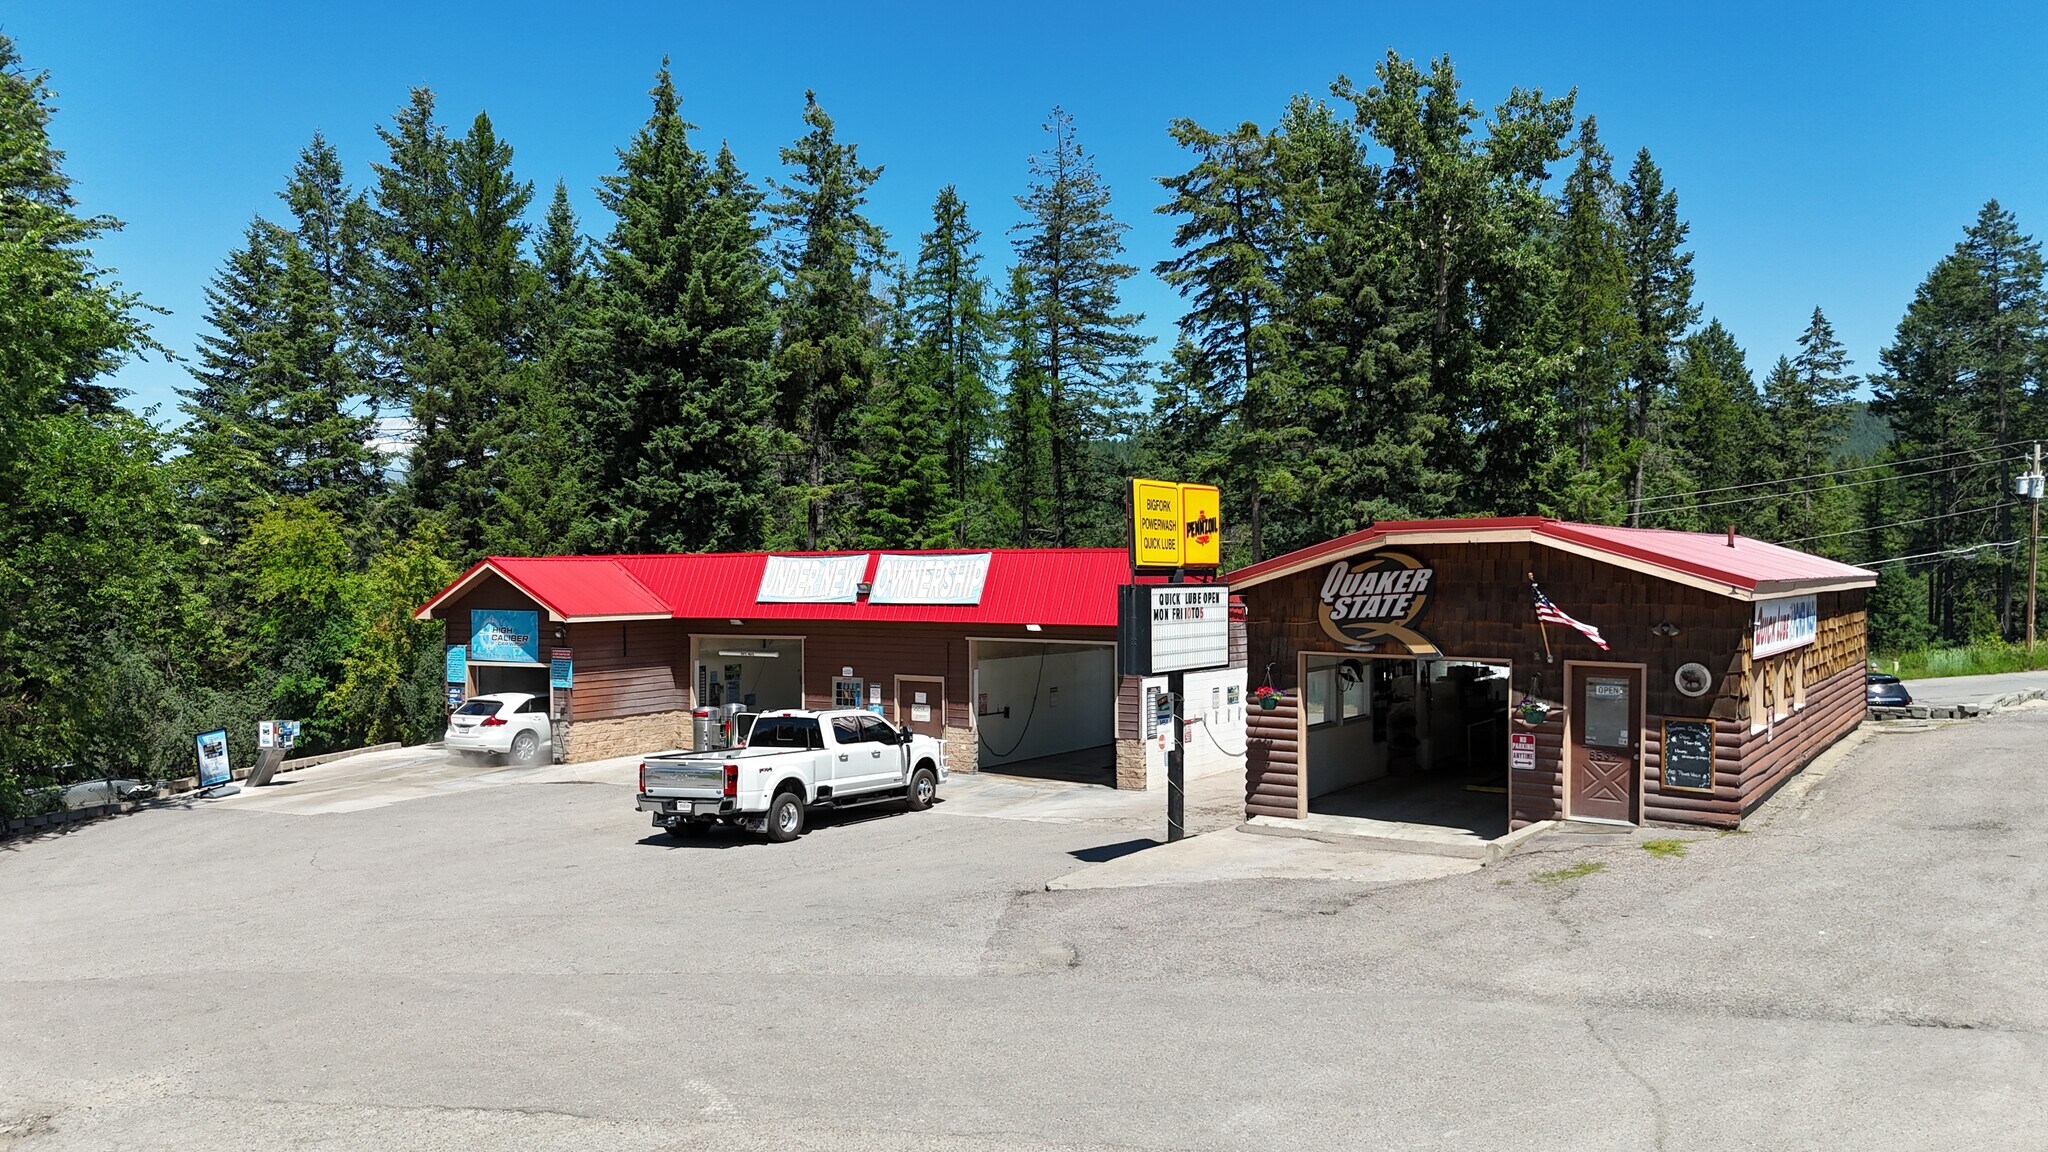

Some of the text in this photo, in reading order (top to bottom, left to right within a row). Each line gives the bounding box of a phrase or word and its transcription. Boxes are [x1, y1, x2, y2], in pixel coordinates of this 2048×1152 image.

[1146, 498, 1171, 512] BIGFORK
[1142, 518, 1176, 531] POWERWASH
[1186, 517, 1218, 538] PENNZOIL
[1144, 537, 1176, 550] QUICK LUBE
[764, 558, 862, 597] UNDER NEW
[874, 557, 987, 598] OWNERSHIP
[1320, 561, 1433, 603] QUAKER
[1159, 592, 1220, 606] QUICK LUBE OPEN
[1330, 593, 1413, 620] STATE
[1153, 608, 1169, 621] MON
[1172, 608, 1183, 620] FRI
[492, 626, 513, 634] HIGH
[491, 634, 529, 642] CALIBER
[1598, 686, 1619, 694] OPEN
[1513, 752, 1534, 760] ANYTIME
